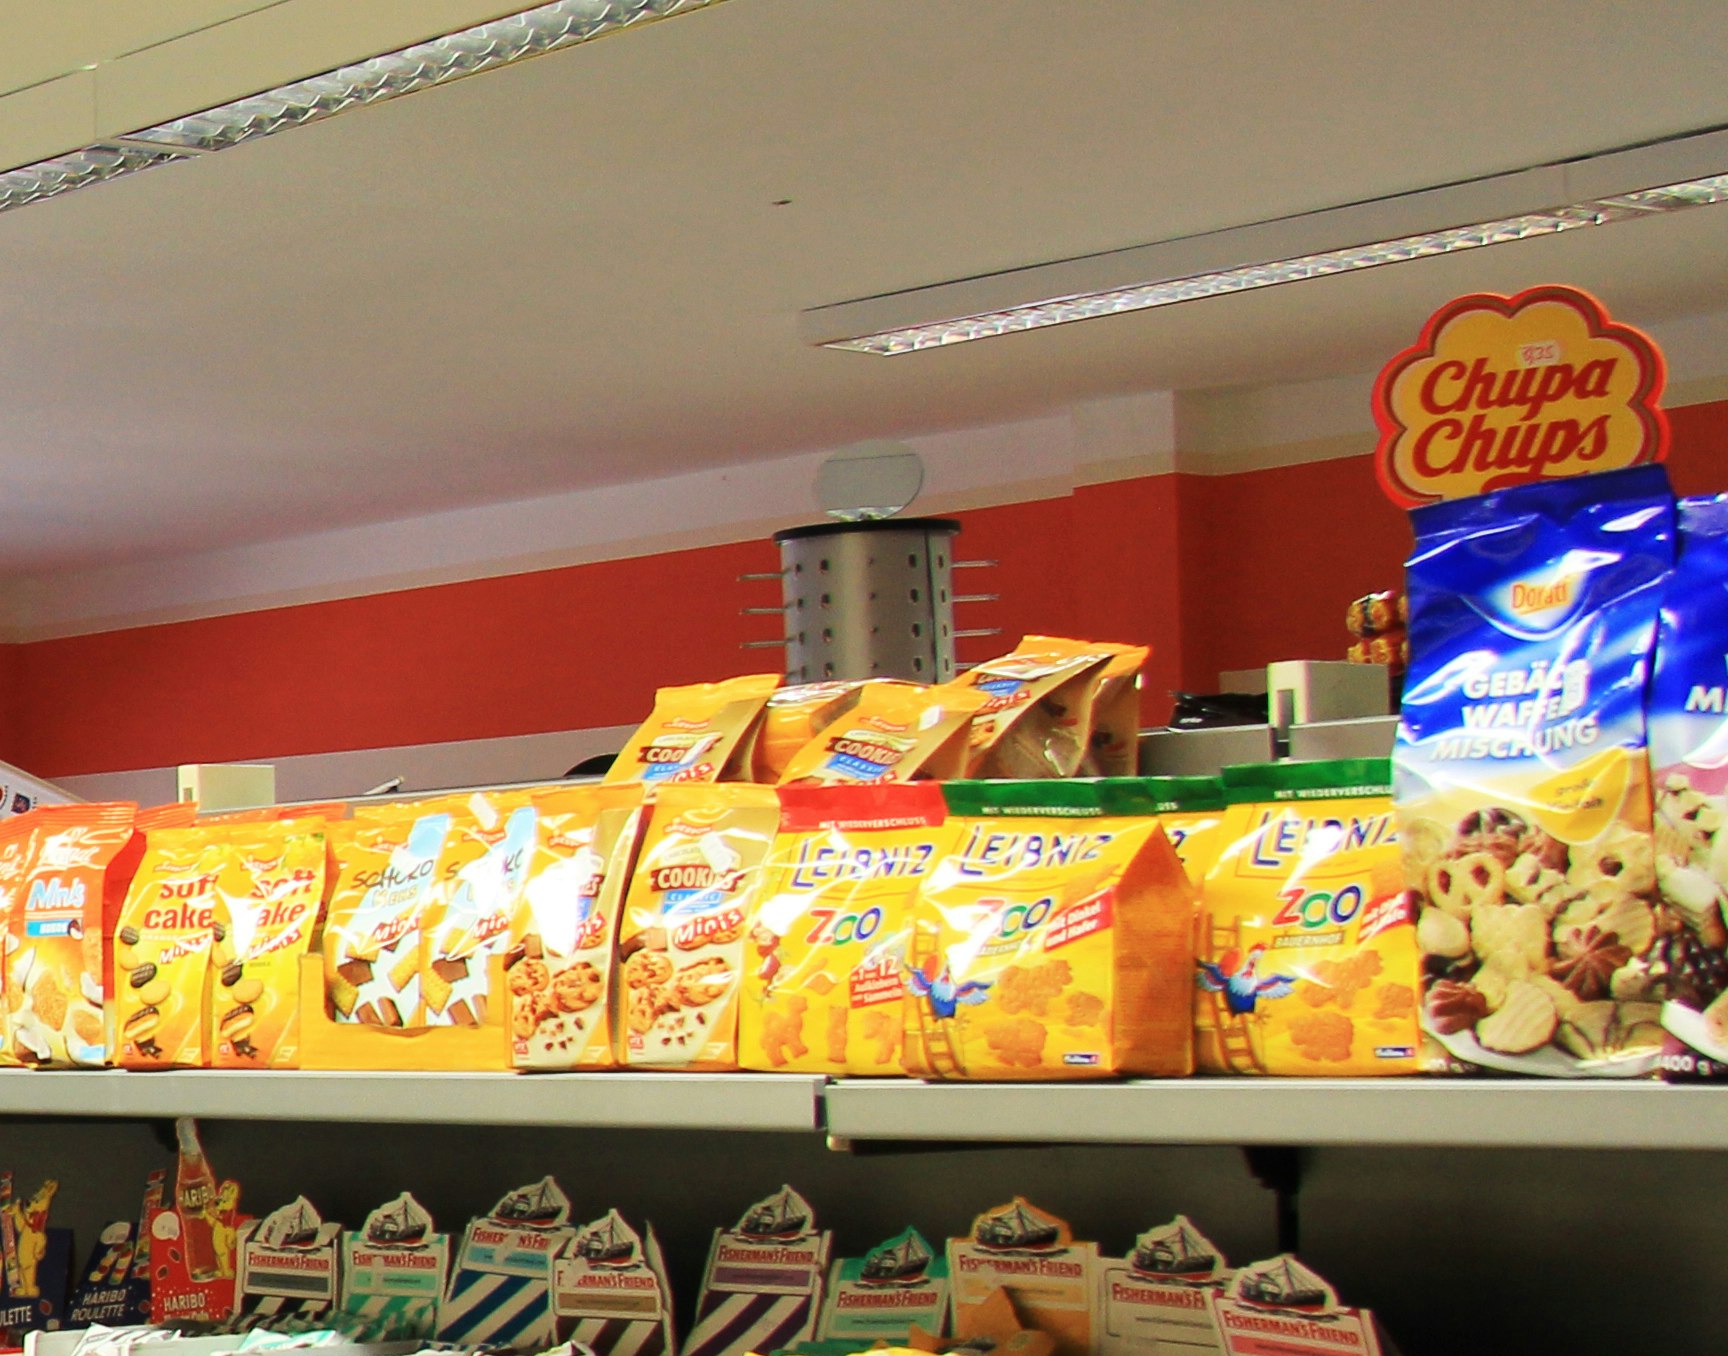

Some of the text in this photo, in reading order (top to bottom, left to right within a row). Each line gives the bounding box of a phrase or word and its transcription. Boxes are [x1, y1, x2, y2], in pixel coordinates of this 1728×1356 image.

[1420, 357, 1617, 421] Chupa
[1413, 415, 1611, 479] Chups
[1430, 720, 1598, 762] MISCHUNG
[1296, 785, 1391, 799] WIEDERVERSCHLU
[792, 838, 933, 887] LEIBNIZ
[960, 826, 1111, 876] LEIBNIZ
[25, 880, 85, 913] Minis
[1272, 884, 1362, 929] ZOO
[144, 897, 213, 930] cake
[256, 901, 306, 928] ake
[807, 907, 883, 946] ZOO
[674, 911, 741, 946] Minis
[248, 1252, 330, 1270] FISHERMAN'S FRIEND
[403, 1252, 437, 1269] FRIEND
[718, 1245, 815, 1265] FISHERMAN'S FRIEND
[1039, 1256, 1083, 1279] FRIEND
[619, 1272, 655, 1289] FRIEND
[82, 1288, 127, 1307] HARIBO
[163, 1292, 206, 1310] HARIBO
[837, 1289, 938, 1308] FISHERMAN'S FRIEND
[1112, 1283, 1194, 1306] FISHERMAN'S
[71, 1303, 126, 1321] ROULETTE
[1223, 1310, 1359, 1346] FISHERMAN'S FRIEND
